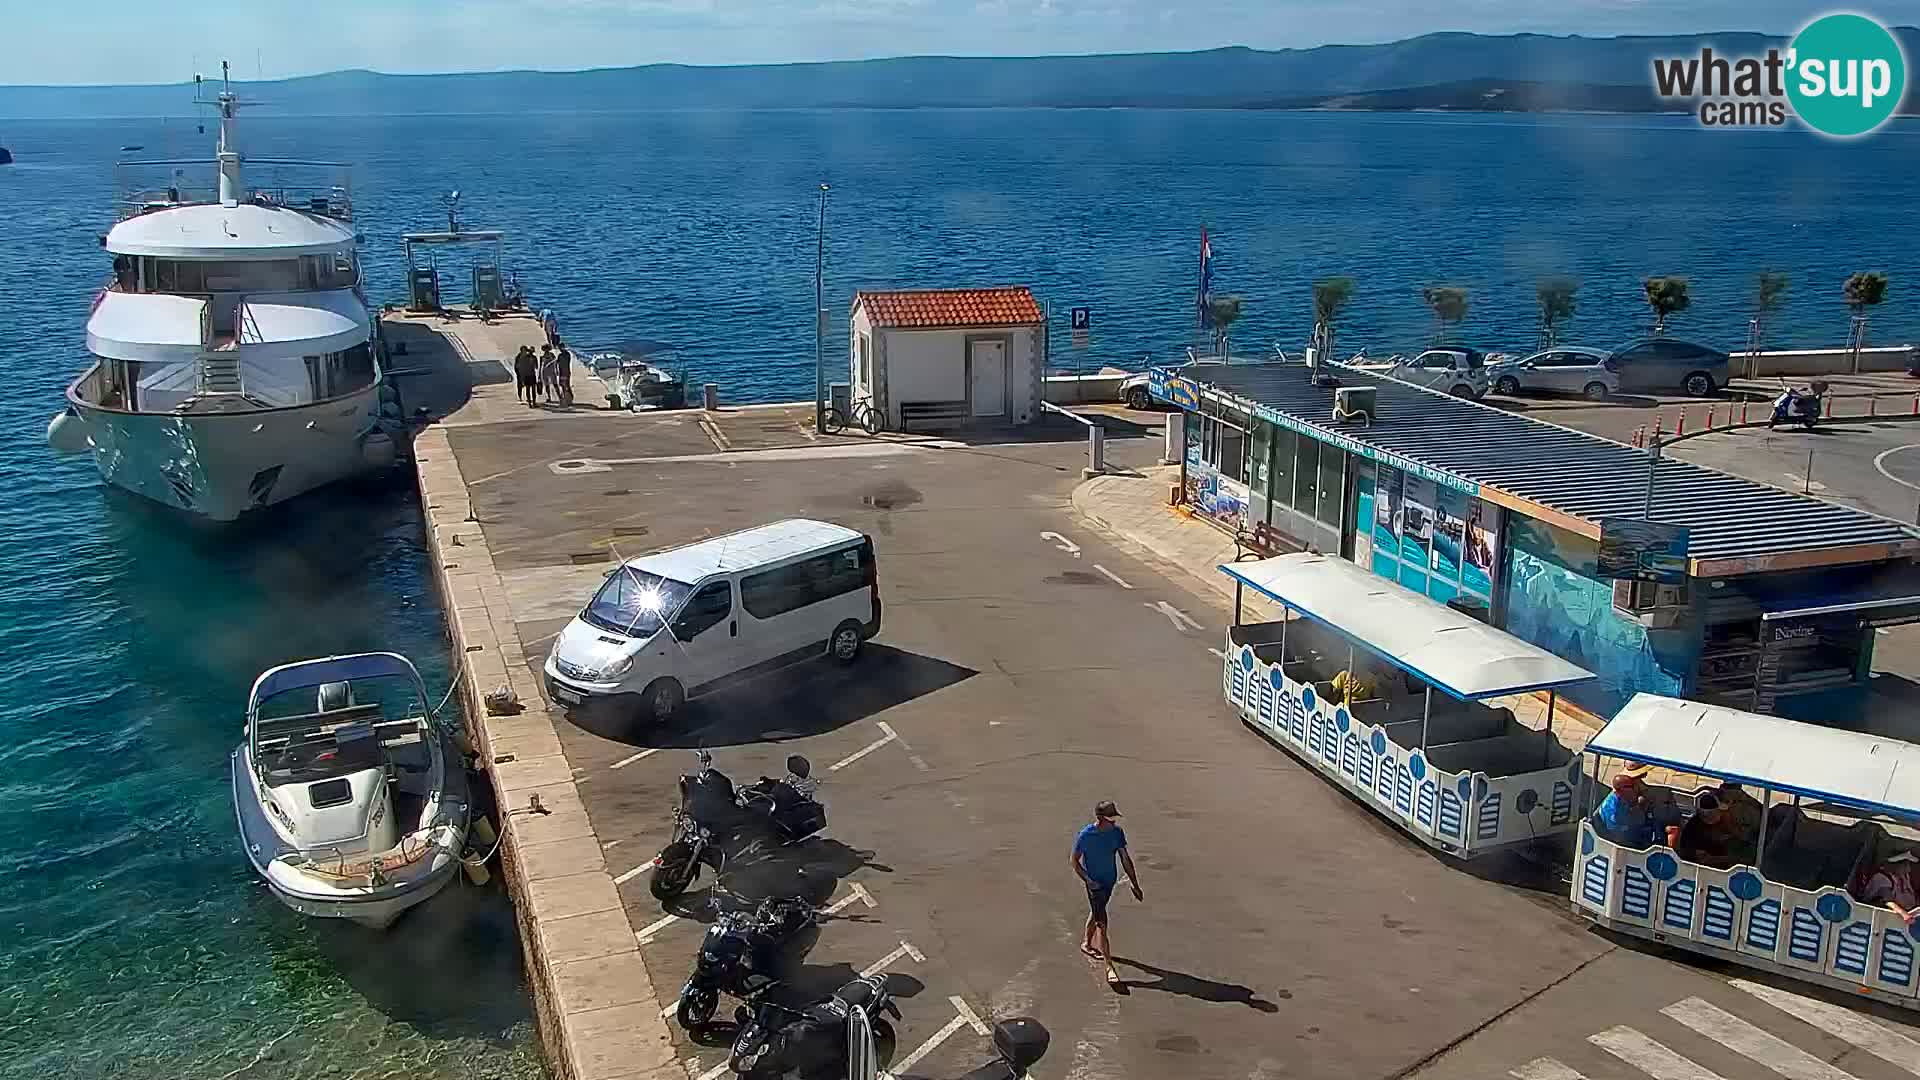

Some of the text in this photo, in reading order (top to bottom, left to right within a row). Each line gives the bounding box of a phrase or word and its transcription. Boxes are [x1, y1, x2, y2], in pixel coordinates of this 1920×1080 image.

[1075, 310, 1086, 326] P
[1389, 455, 1419, 473] STATION
[1422, 466, 1447, 483] TICKET
[1448, 475, 1474, 493] OFFICE
